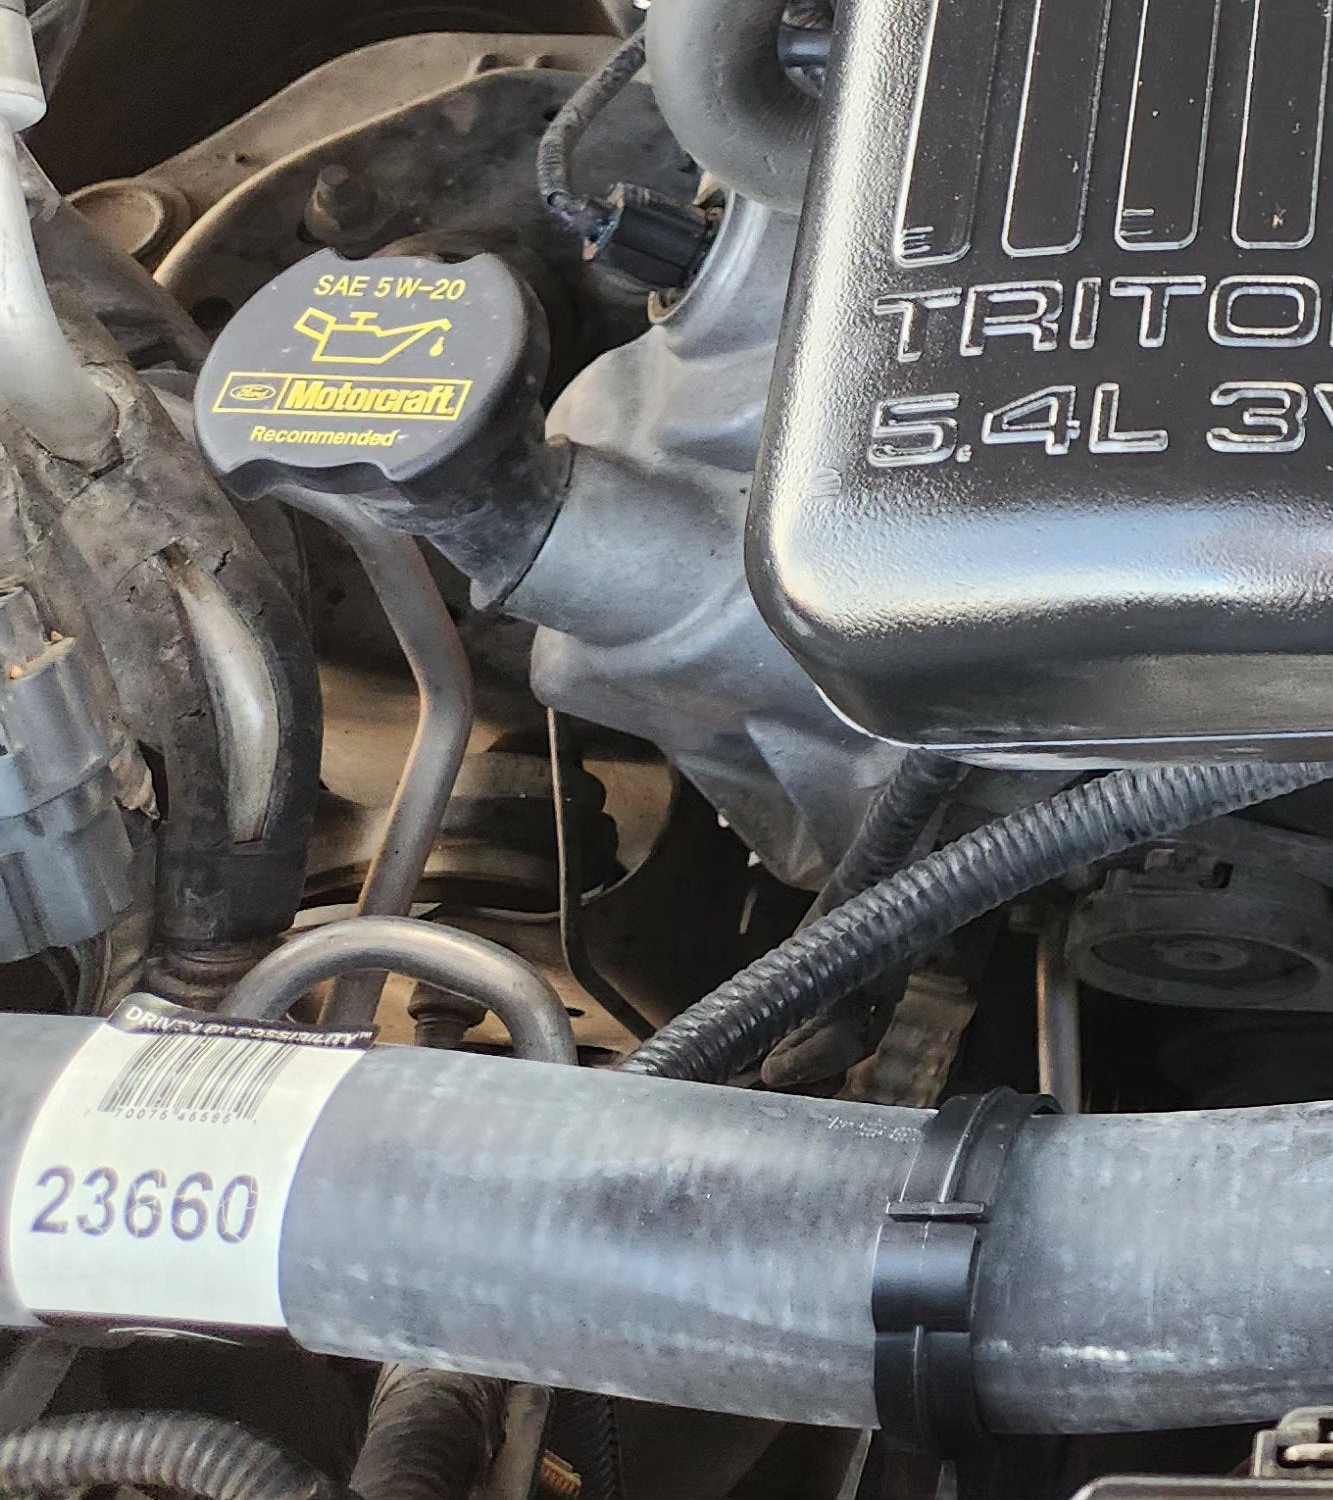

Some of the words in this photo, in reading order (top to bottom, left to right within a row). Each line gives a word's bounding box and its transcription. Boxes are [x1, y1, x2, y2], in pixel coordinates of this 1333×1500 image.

[313, 274, 370, 297] SAE
[250, 425, 397, 446] Recommended
[867, 381, 1169, 467] 5.4L
[30, 1163, 260, 1244] 23660
